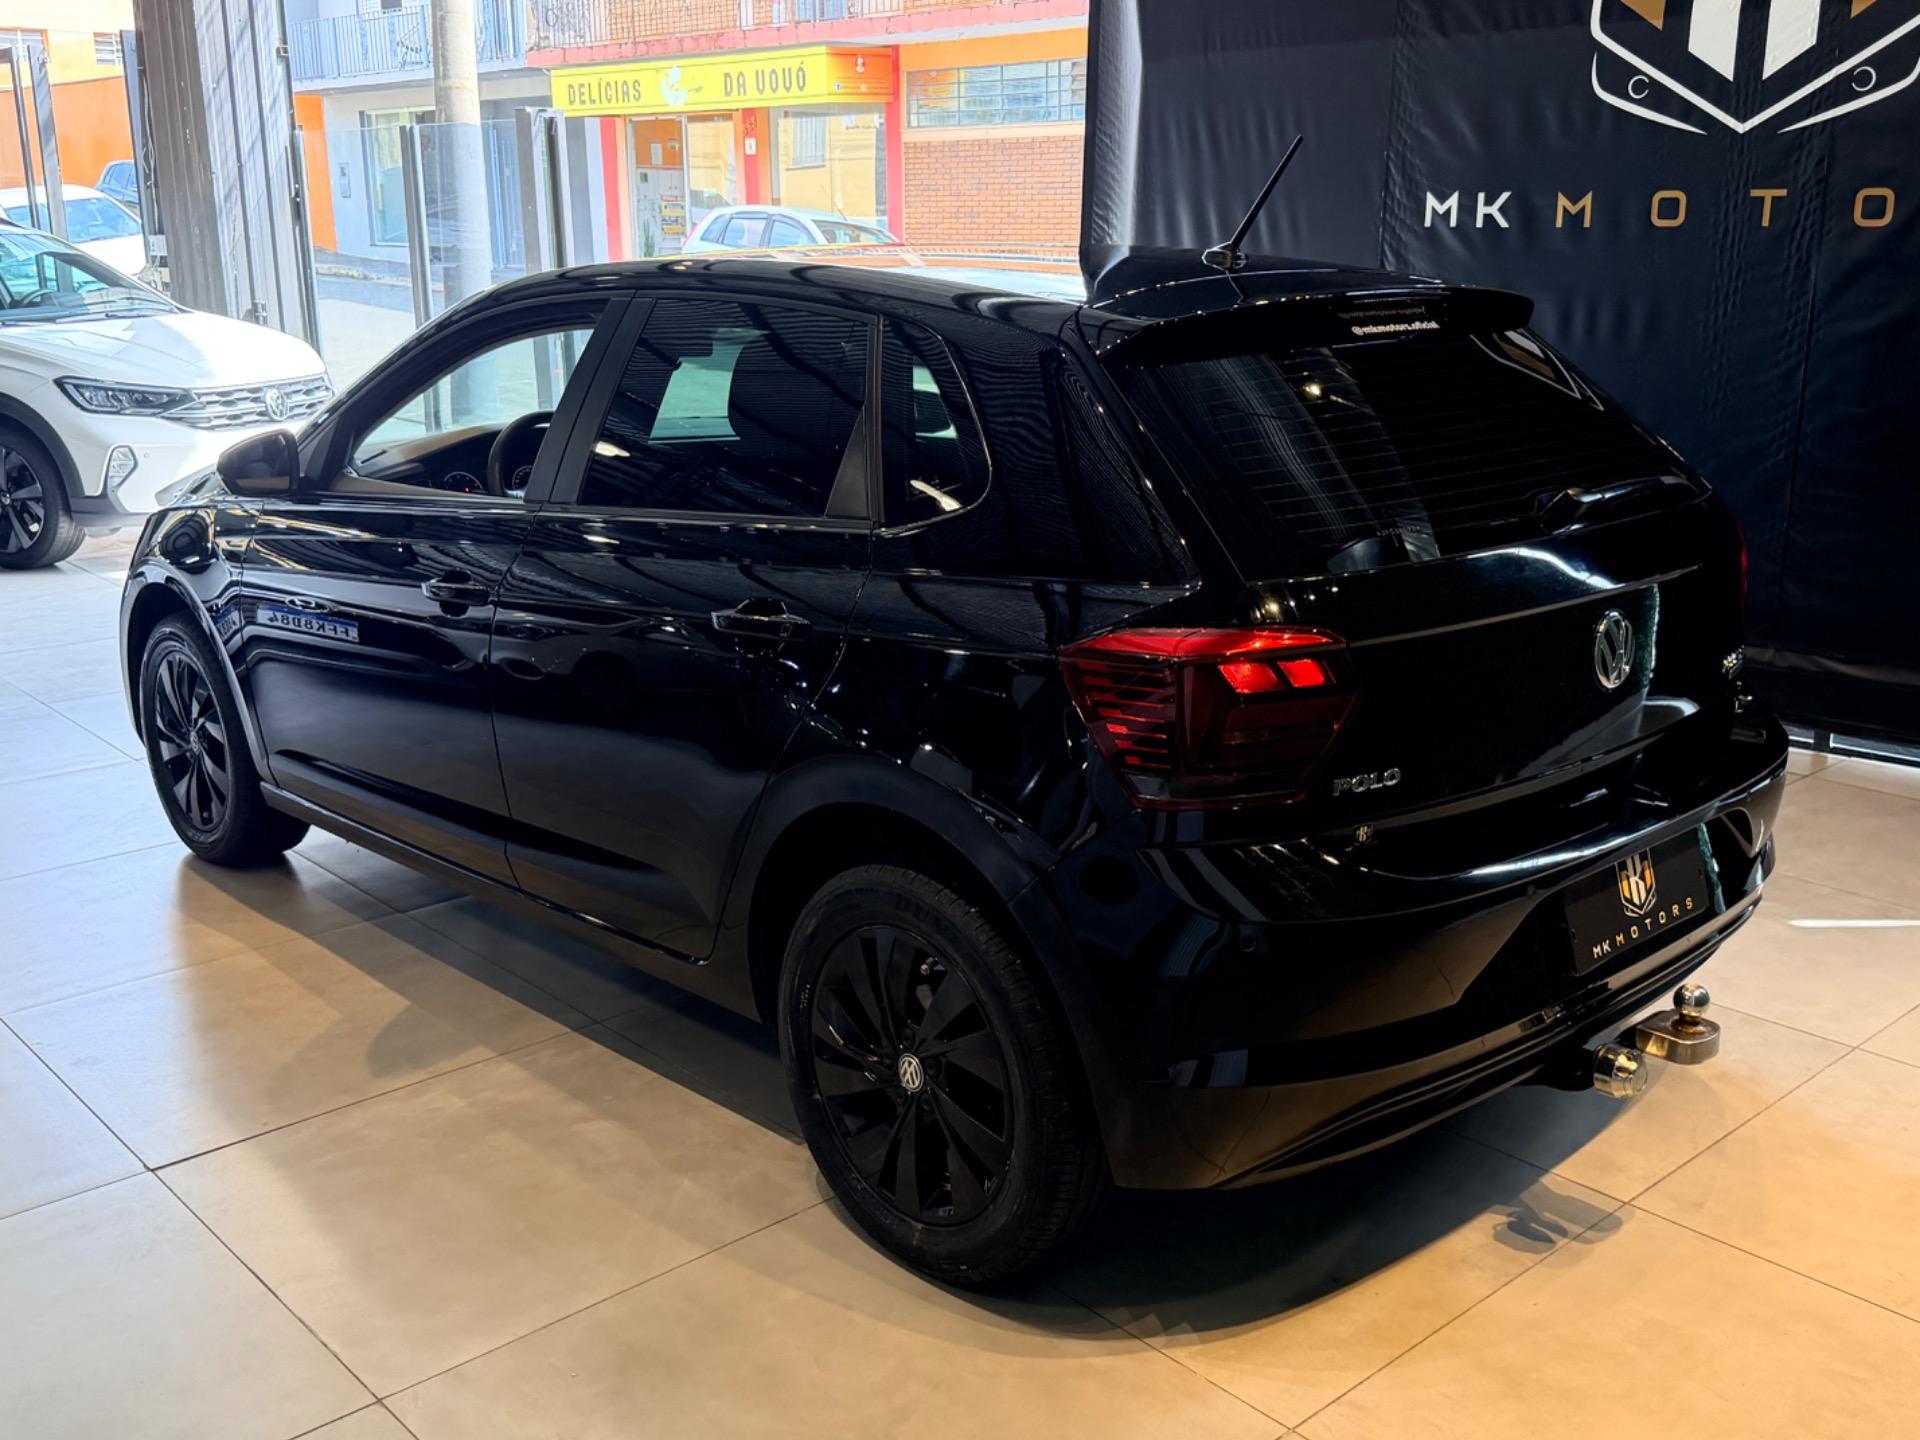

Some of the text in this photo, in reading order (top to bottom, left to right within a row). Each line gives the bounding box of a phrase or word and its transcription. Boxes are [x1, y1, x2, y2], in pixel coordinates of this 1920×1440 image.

[567, 78, 641, 106] DELÍCIAS
[723, 72, 747, 97] DA
[1424, 191, 1512, 228] MK
[1332, 768, 1401, 796] POLO
[1592, 896, 1695, 959] MK MOTORS
